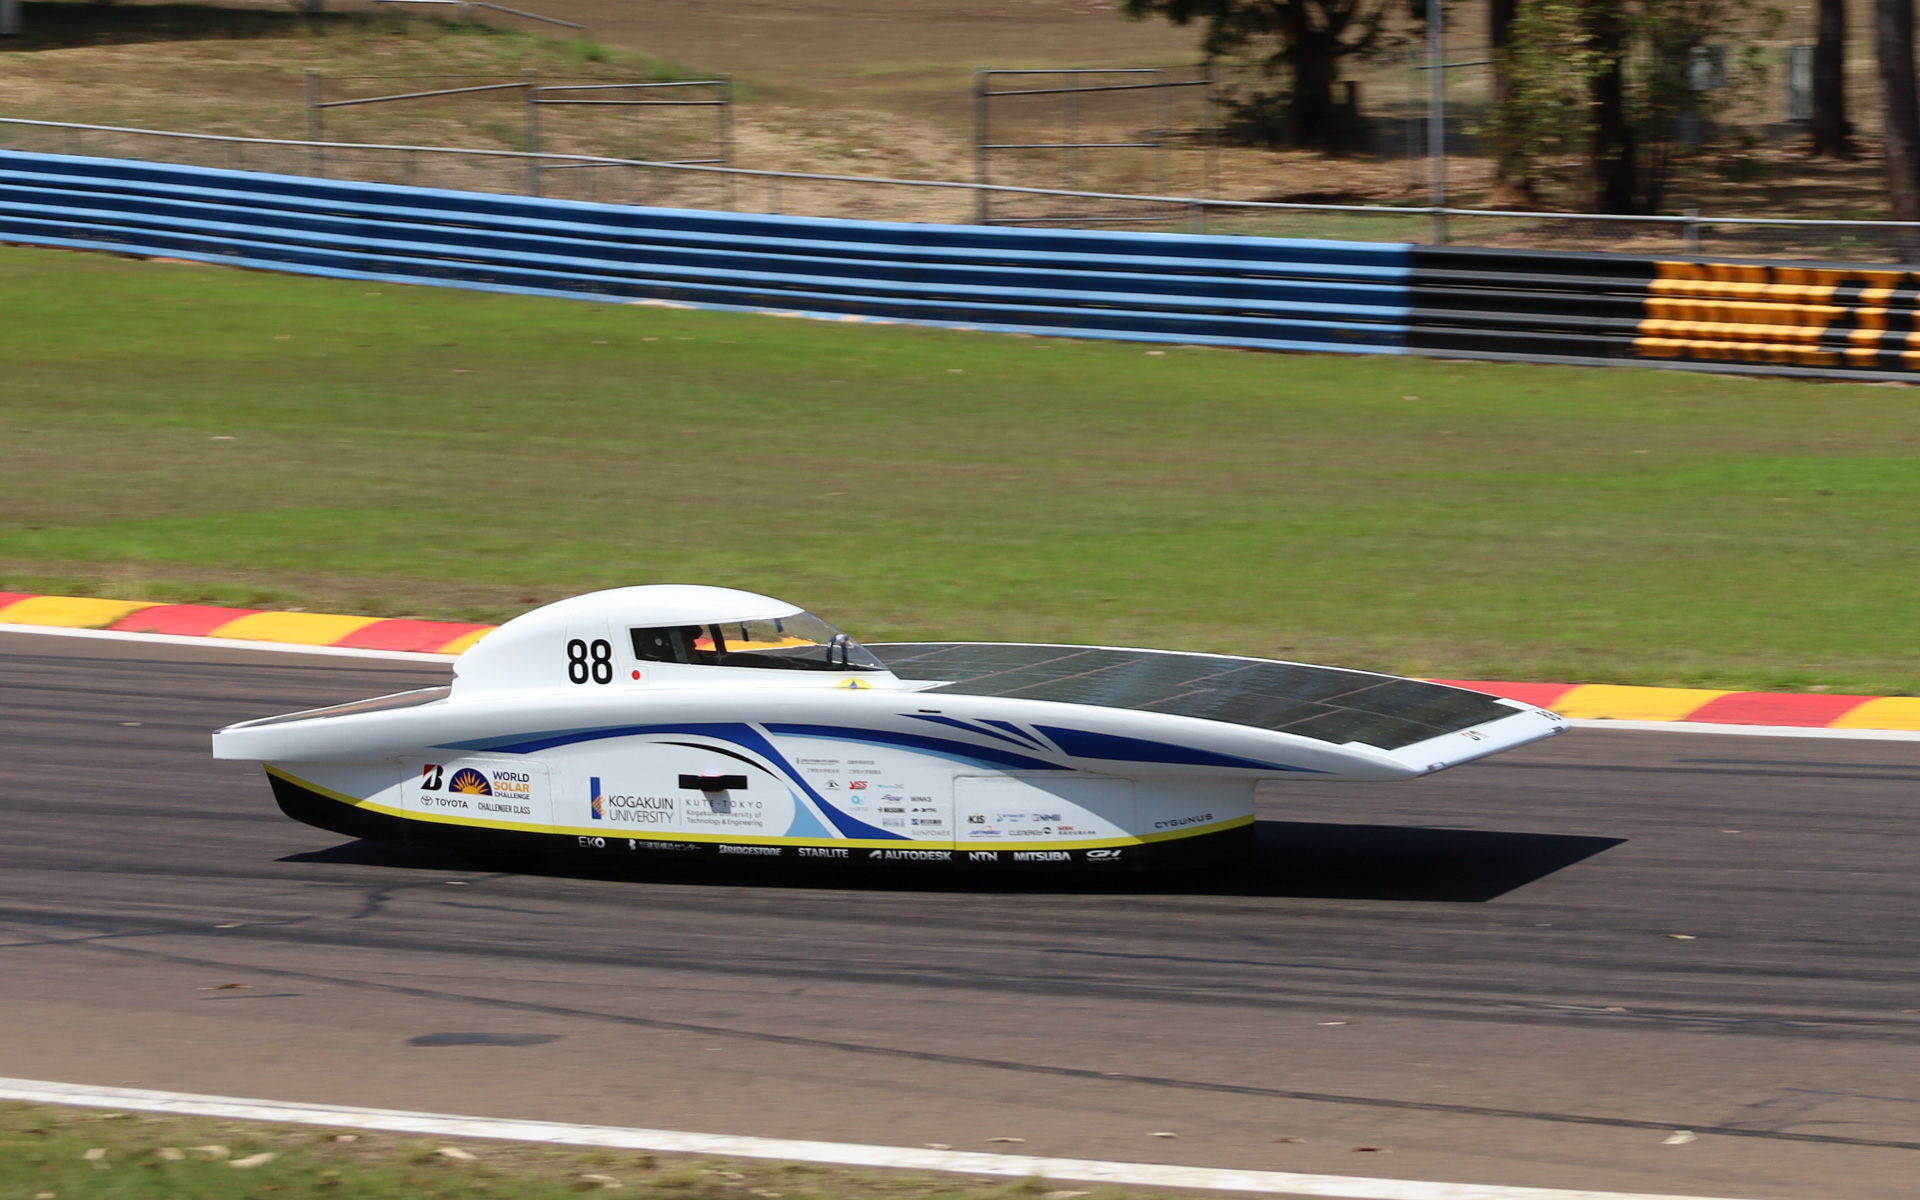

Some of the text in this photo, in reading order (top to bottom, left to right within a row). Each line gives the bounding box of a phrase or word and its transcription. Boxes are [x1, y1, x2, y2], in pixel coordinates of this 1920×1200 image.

[567, 639, 613, 685] 88
[493, 771, 530, 783] WORLD
[493, 781, 530, 792] SOLAR
[494, 791, 530, 800] CHALLENGE
[435, 798, 468, 809] TOYOTA
[478, 802, 531, 815] CHALLENGER CLASS
[608, 795, 674, 811] KOGAKUIN
[609, 810, 674, 824] UNIVERSITY
[578, 836, 606, 849] EKO
[719, 844, 782, 856] BRIDGESTONE
[798, 848, 849, 859] STARLITE
[885, 850, 952, 861] AUTODESK
[968, 851, 998, 862] NTN
[1013, 851, 1071, 861] MITSUBA
